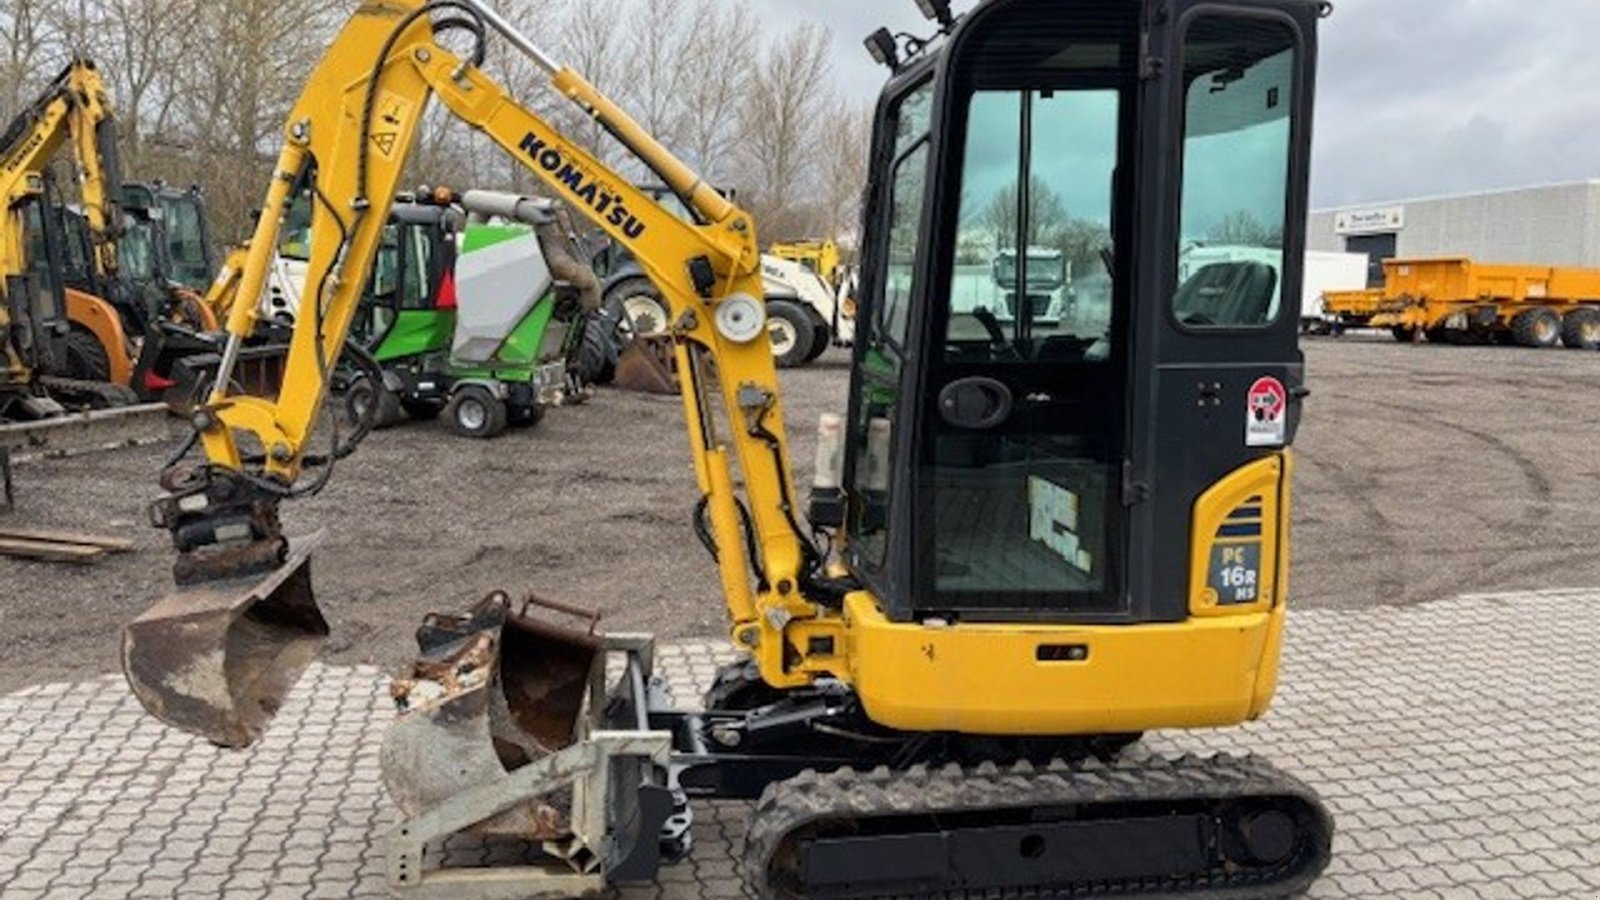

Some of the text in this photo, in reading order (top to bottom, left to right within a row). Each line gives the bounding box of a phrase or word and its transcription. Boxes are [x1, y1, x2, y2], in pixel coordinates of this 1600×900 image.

[518, 131, 646, 239] KOMATSU
[1222, 546, 1245, 565] PC
[1220, 566, 1256, 587] 16R
